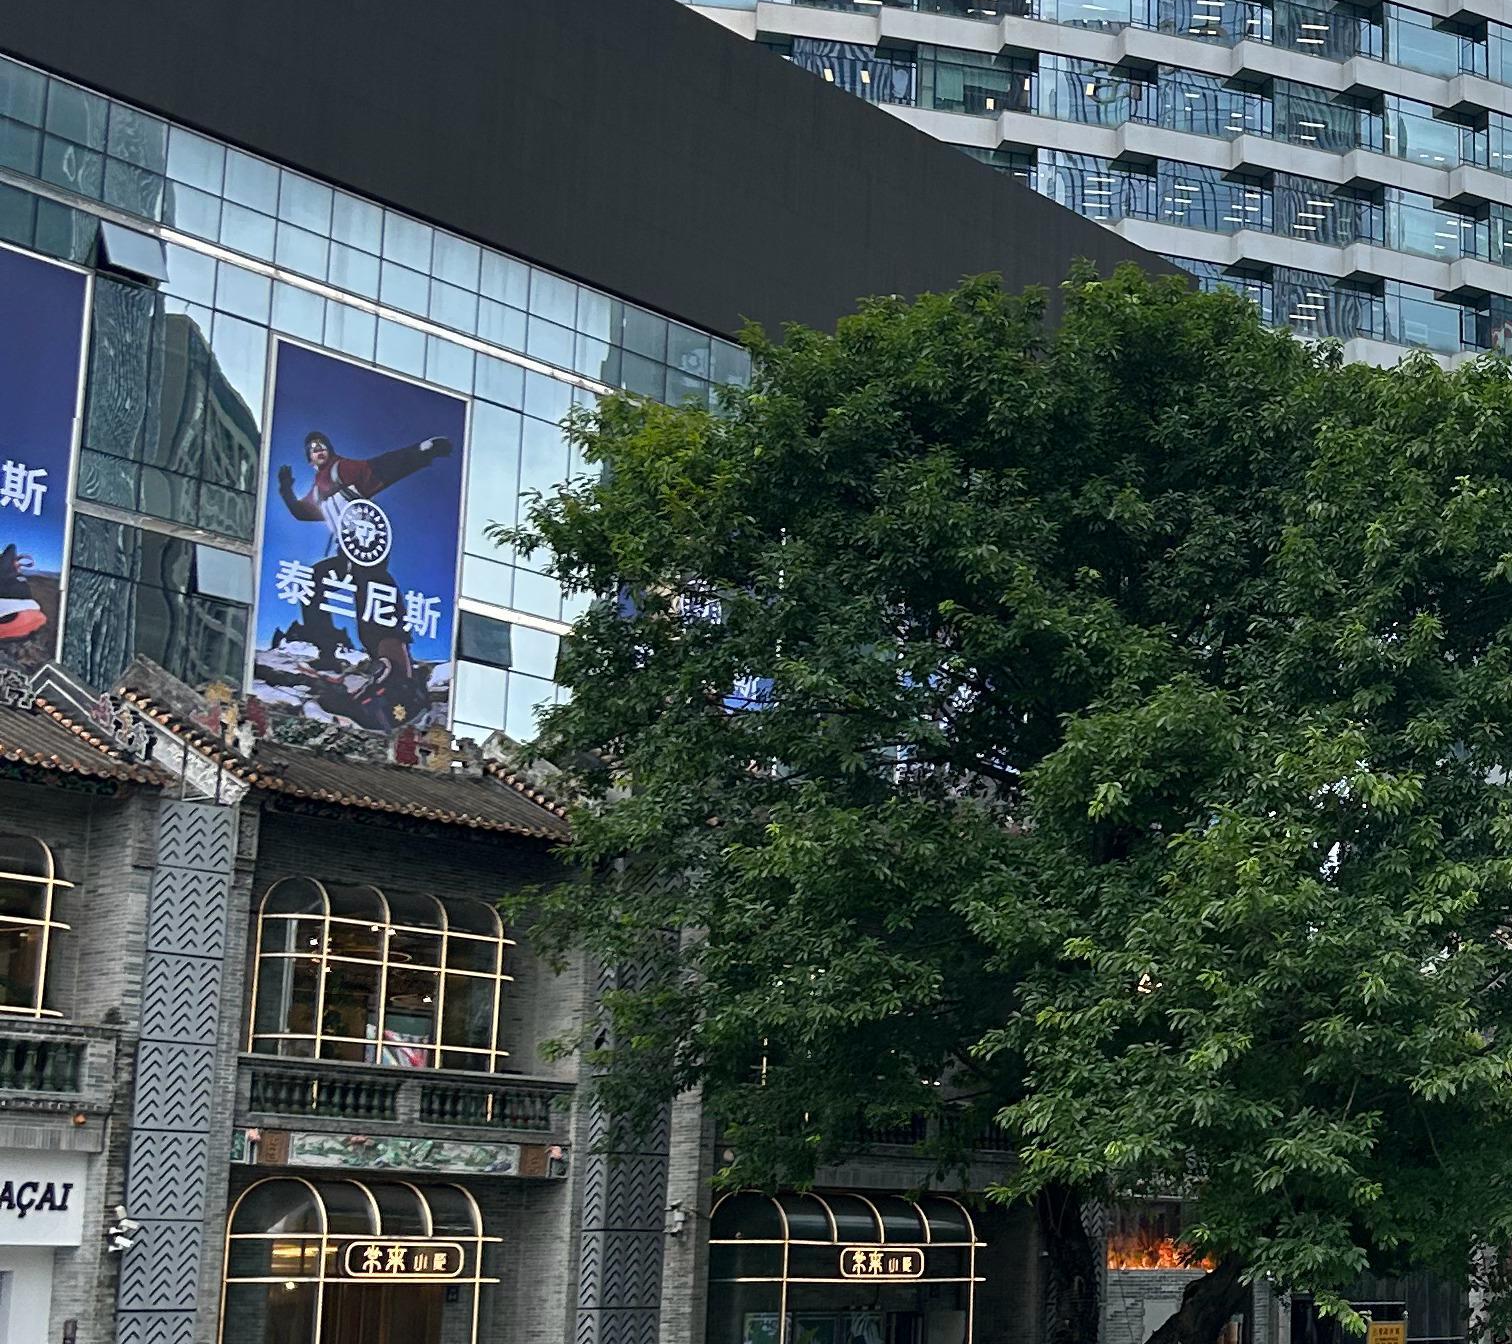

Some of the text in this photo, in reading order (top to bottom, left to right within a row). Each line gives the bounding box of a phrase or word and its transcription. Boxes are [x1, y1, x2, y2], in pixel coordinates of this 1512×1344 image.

[0, 460, 48, 516] 斯
[275, 559, 441, 639] 泰兰尼斯
